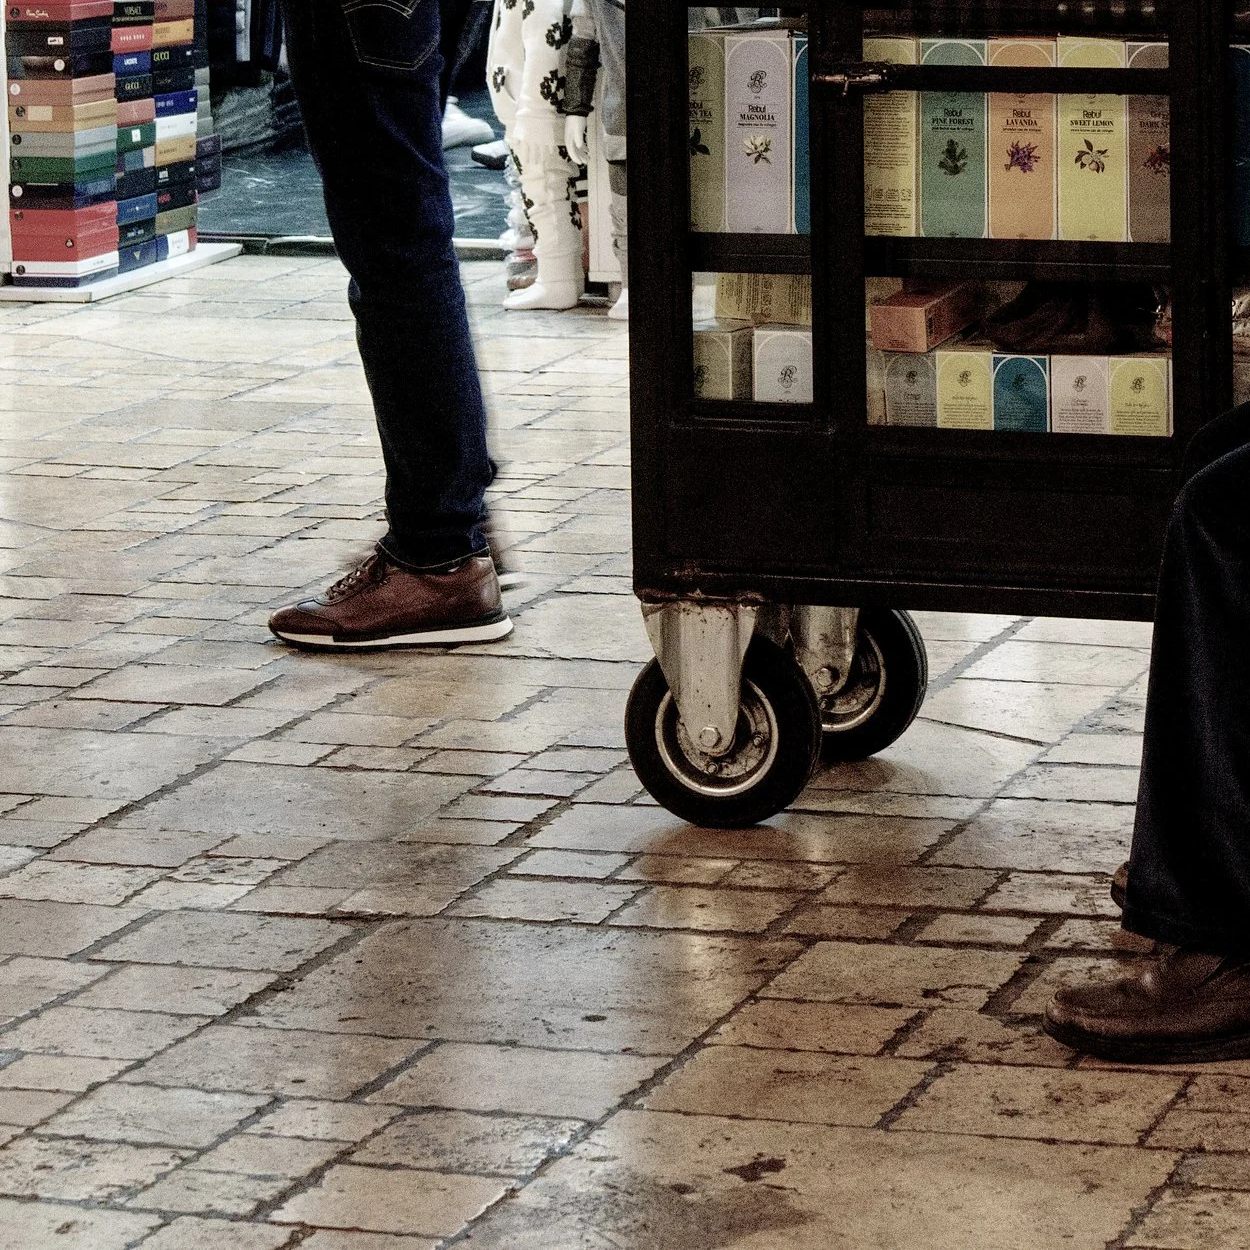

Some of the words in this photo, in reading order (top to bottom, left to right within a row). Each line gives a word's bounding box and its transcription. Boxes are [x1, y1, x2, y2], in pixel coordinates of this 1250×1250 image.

[740, 113, 775, 121] MAGNOLIA
[1012, 109, 1031, 118] Rebul
[1082, 110, 1101, 119] Rebul
[931, 117, 948, 125] PINE
[949, 117, 974, 125] FOREST
[1006, 118, 1038, 126] LAVANDA
